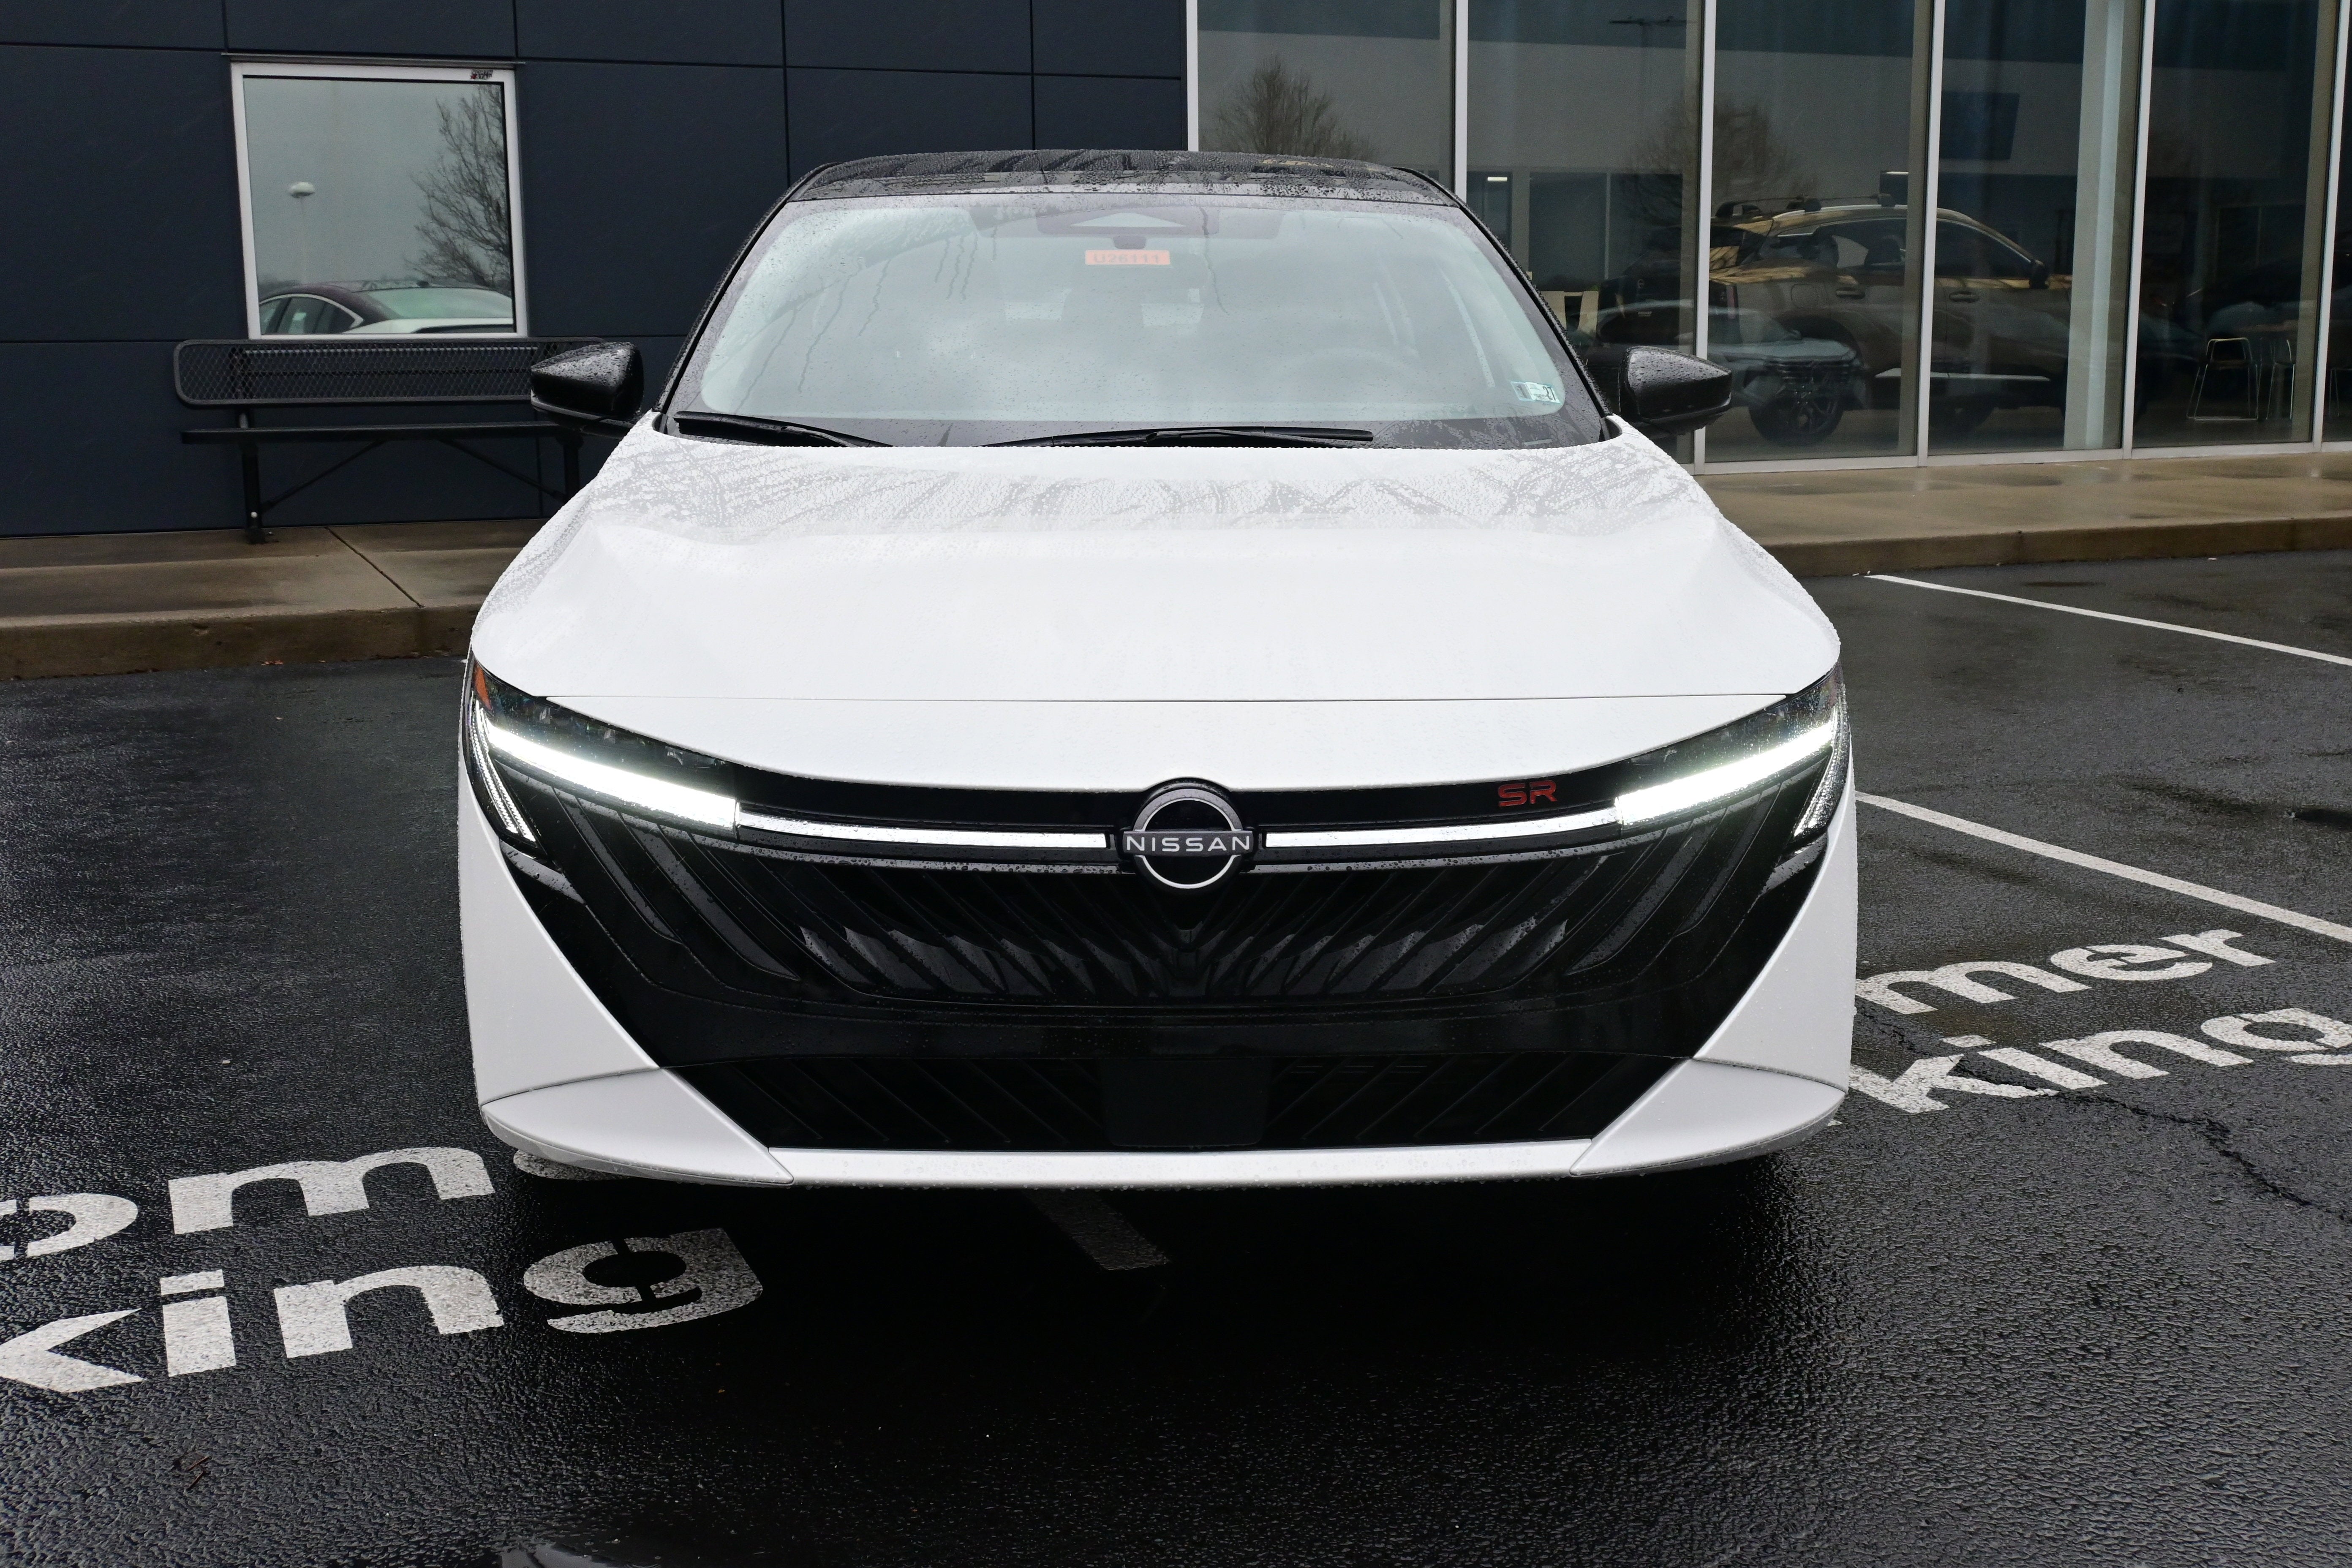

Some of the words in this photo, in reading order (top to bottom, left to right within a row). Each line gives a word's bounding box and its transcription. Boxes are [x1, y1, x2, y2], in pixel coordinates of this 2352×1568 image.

[1542, 386, 1556, 401] 27
[1497, 780, 1557, 808] SR
[1126, 834, 1251, 852] NISSAN
[1827, 1008, 2352, 1125] king
[0, 1147, 629, 1261] om
